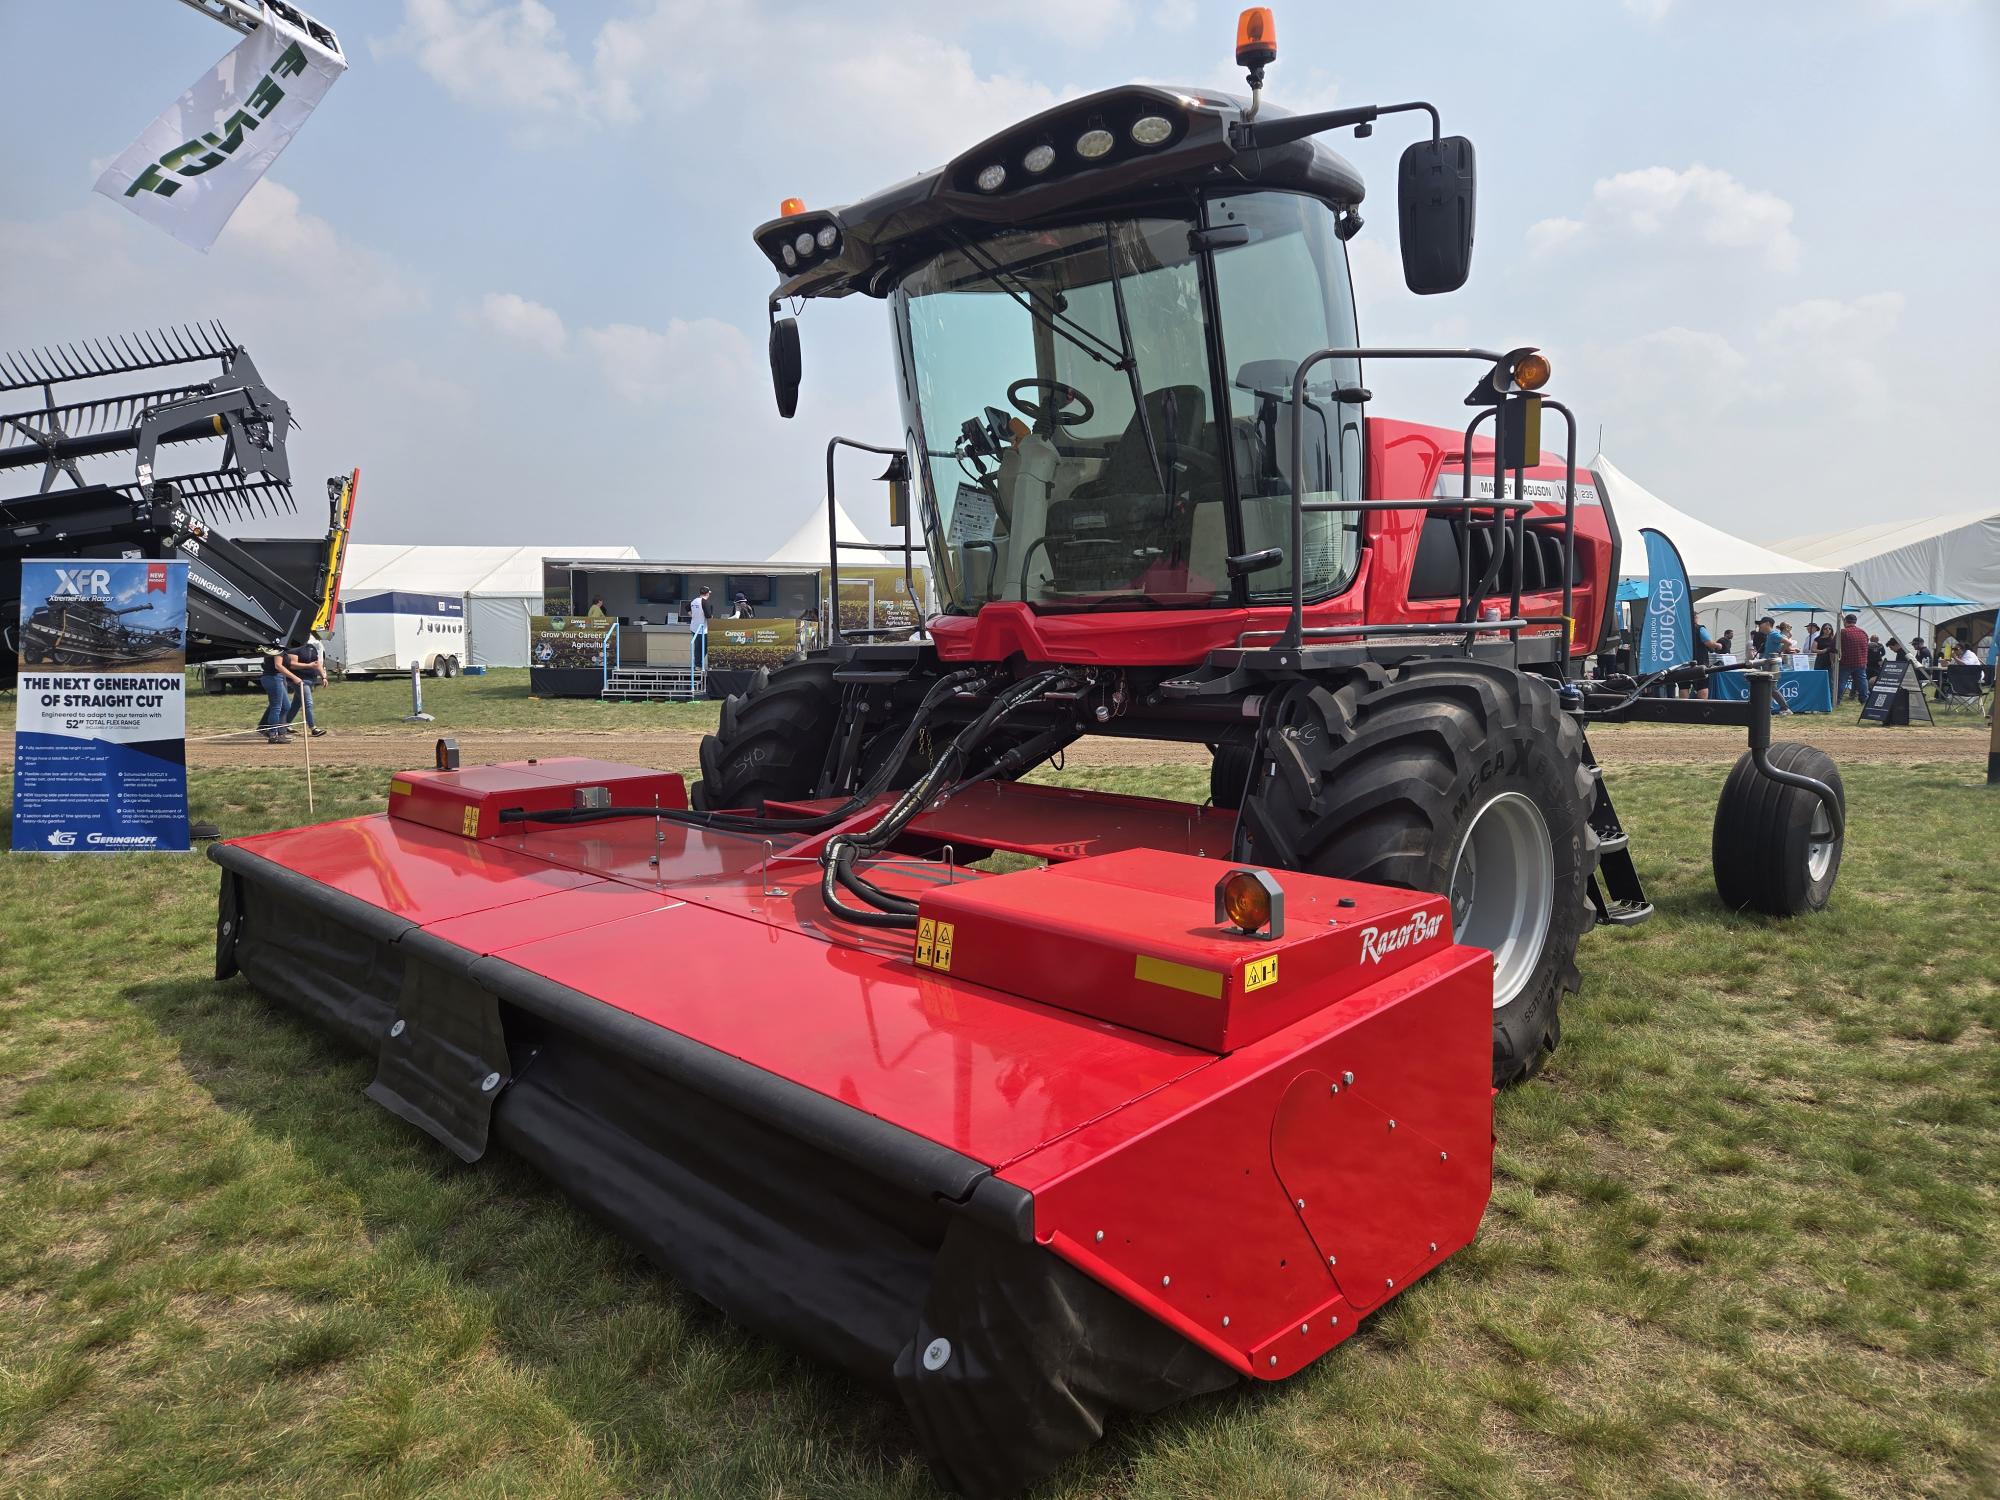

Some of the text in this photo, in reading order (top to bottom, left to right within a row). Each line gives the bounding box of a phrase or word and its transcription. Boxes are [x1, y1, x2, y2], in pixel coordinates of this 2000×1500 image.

[1480, 482, 1512, 495] MAEY
[1520, 484, 1552, 497] RGUSON
[54, 569, 111, 595] XFR
[187, 570, 232, 600] ERINGHOFF
[540, 631, 560, 639] Grow
[561, 631, 577, 639] Your
[578, 631, 602, 639] Career
[571, 641, 610, 650] Agricultue
[23, 677, 180, 691] THE NEXT GENERATION
[40, 694, 164, 708] OF STRAIGHT CUT
[41, 711, 78, 719] Engineered
[87, 711, 107, 719] adapt
